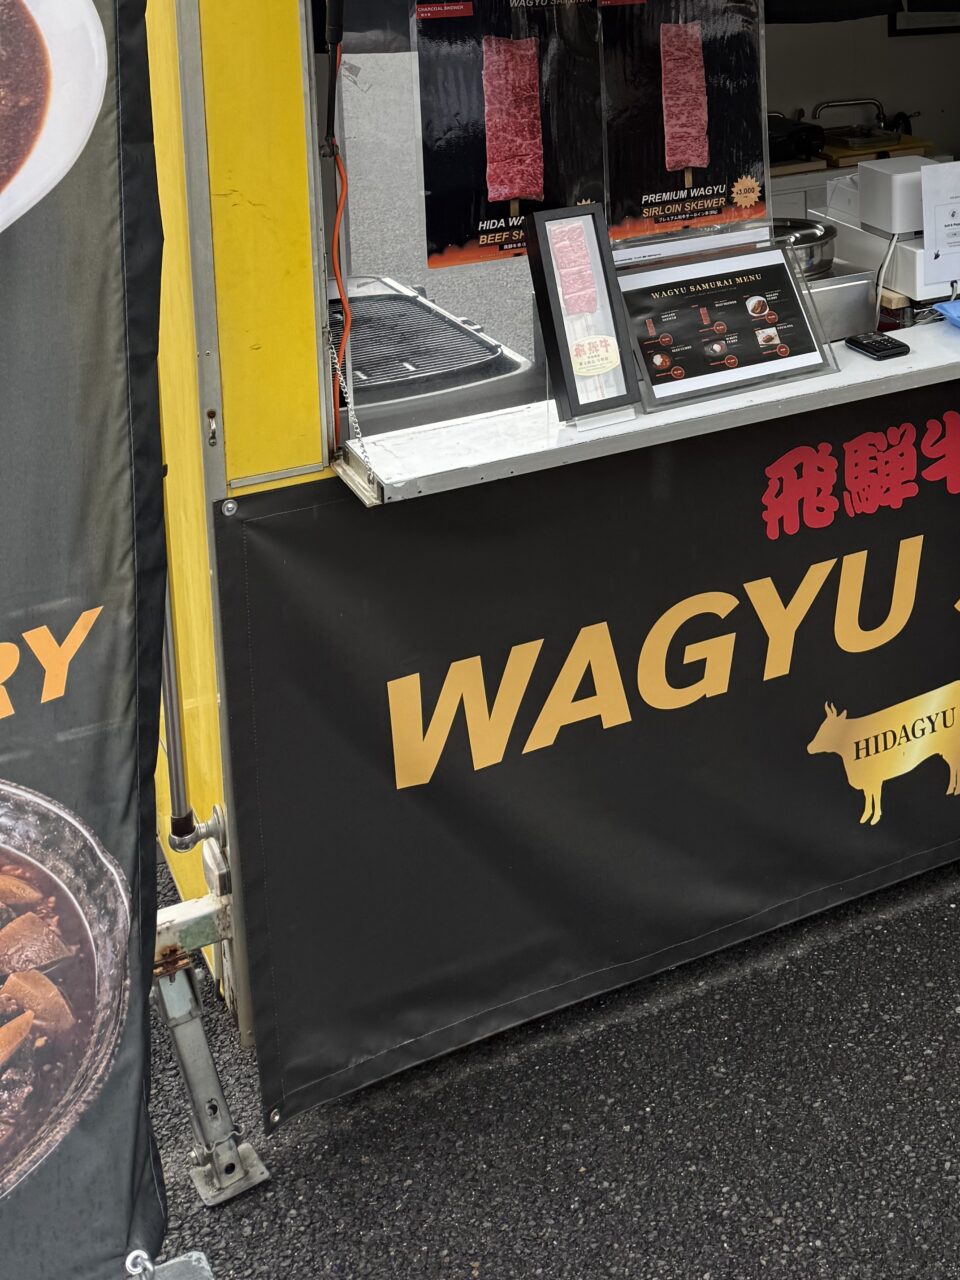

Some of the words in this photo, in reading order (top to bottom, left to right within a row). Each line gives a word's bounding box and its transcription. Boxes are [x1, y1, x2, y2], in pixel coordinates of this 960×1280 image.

[641, 189, 687, 204] PREMIUM
[690, 184, 726, 196] WAGYU
[642, 204, 682, 218] SIRLOIN
[684, 197, 726, 212] SKEWER
[478, 218, 506, 231] HIDA
[479, 231, 510, 245] BEEF
[651, 286, 687, 299] WAGYU
[689, 278, 733, 292] SAMURAI
[735, 273, 762, 284] MENU
[386, 535, 925, 790] WAGYU
[853, 707, 956, 761] HIDAGYU
